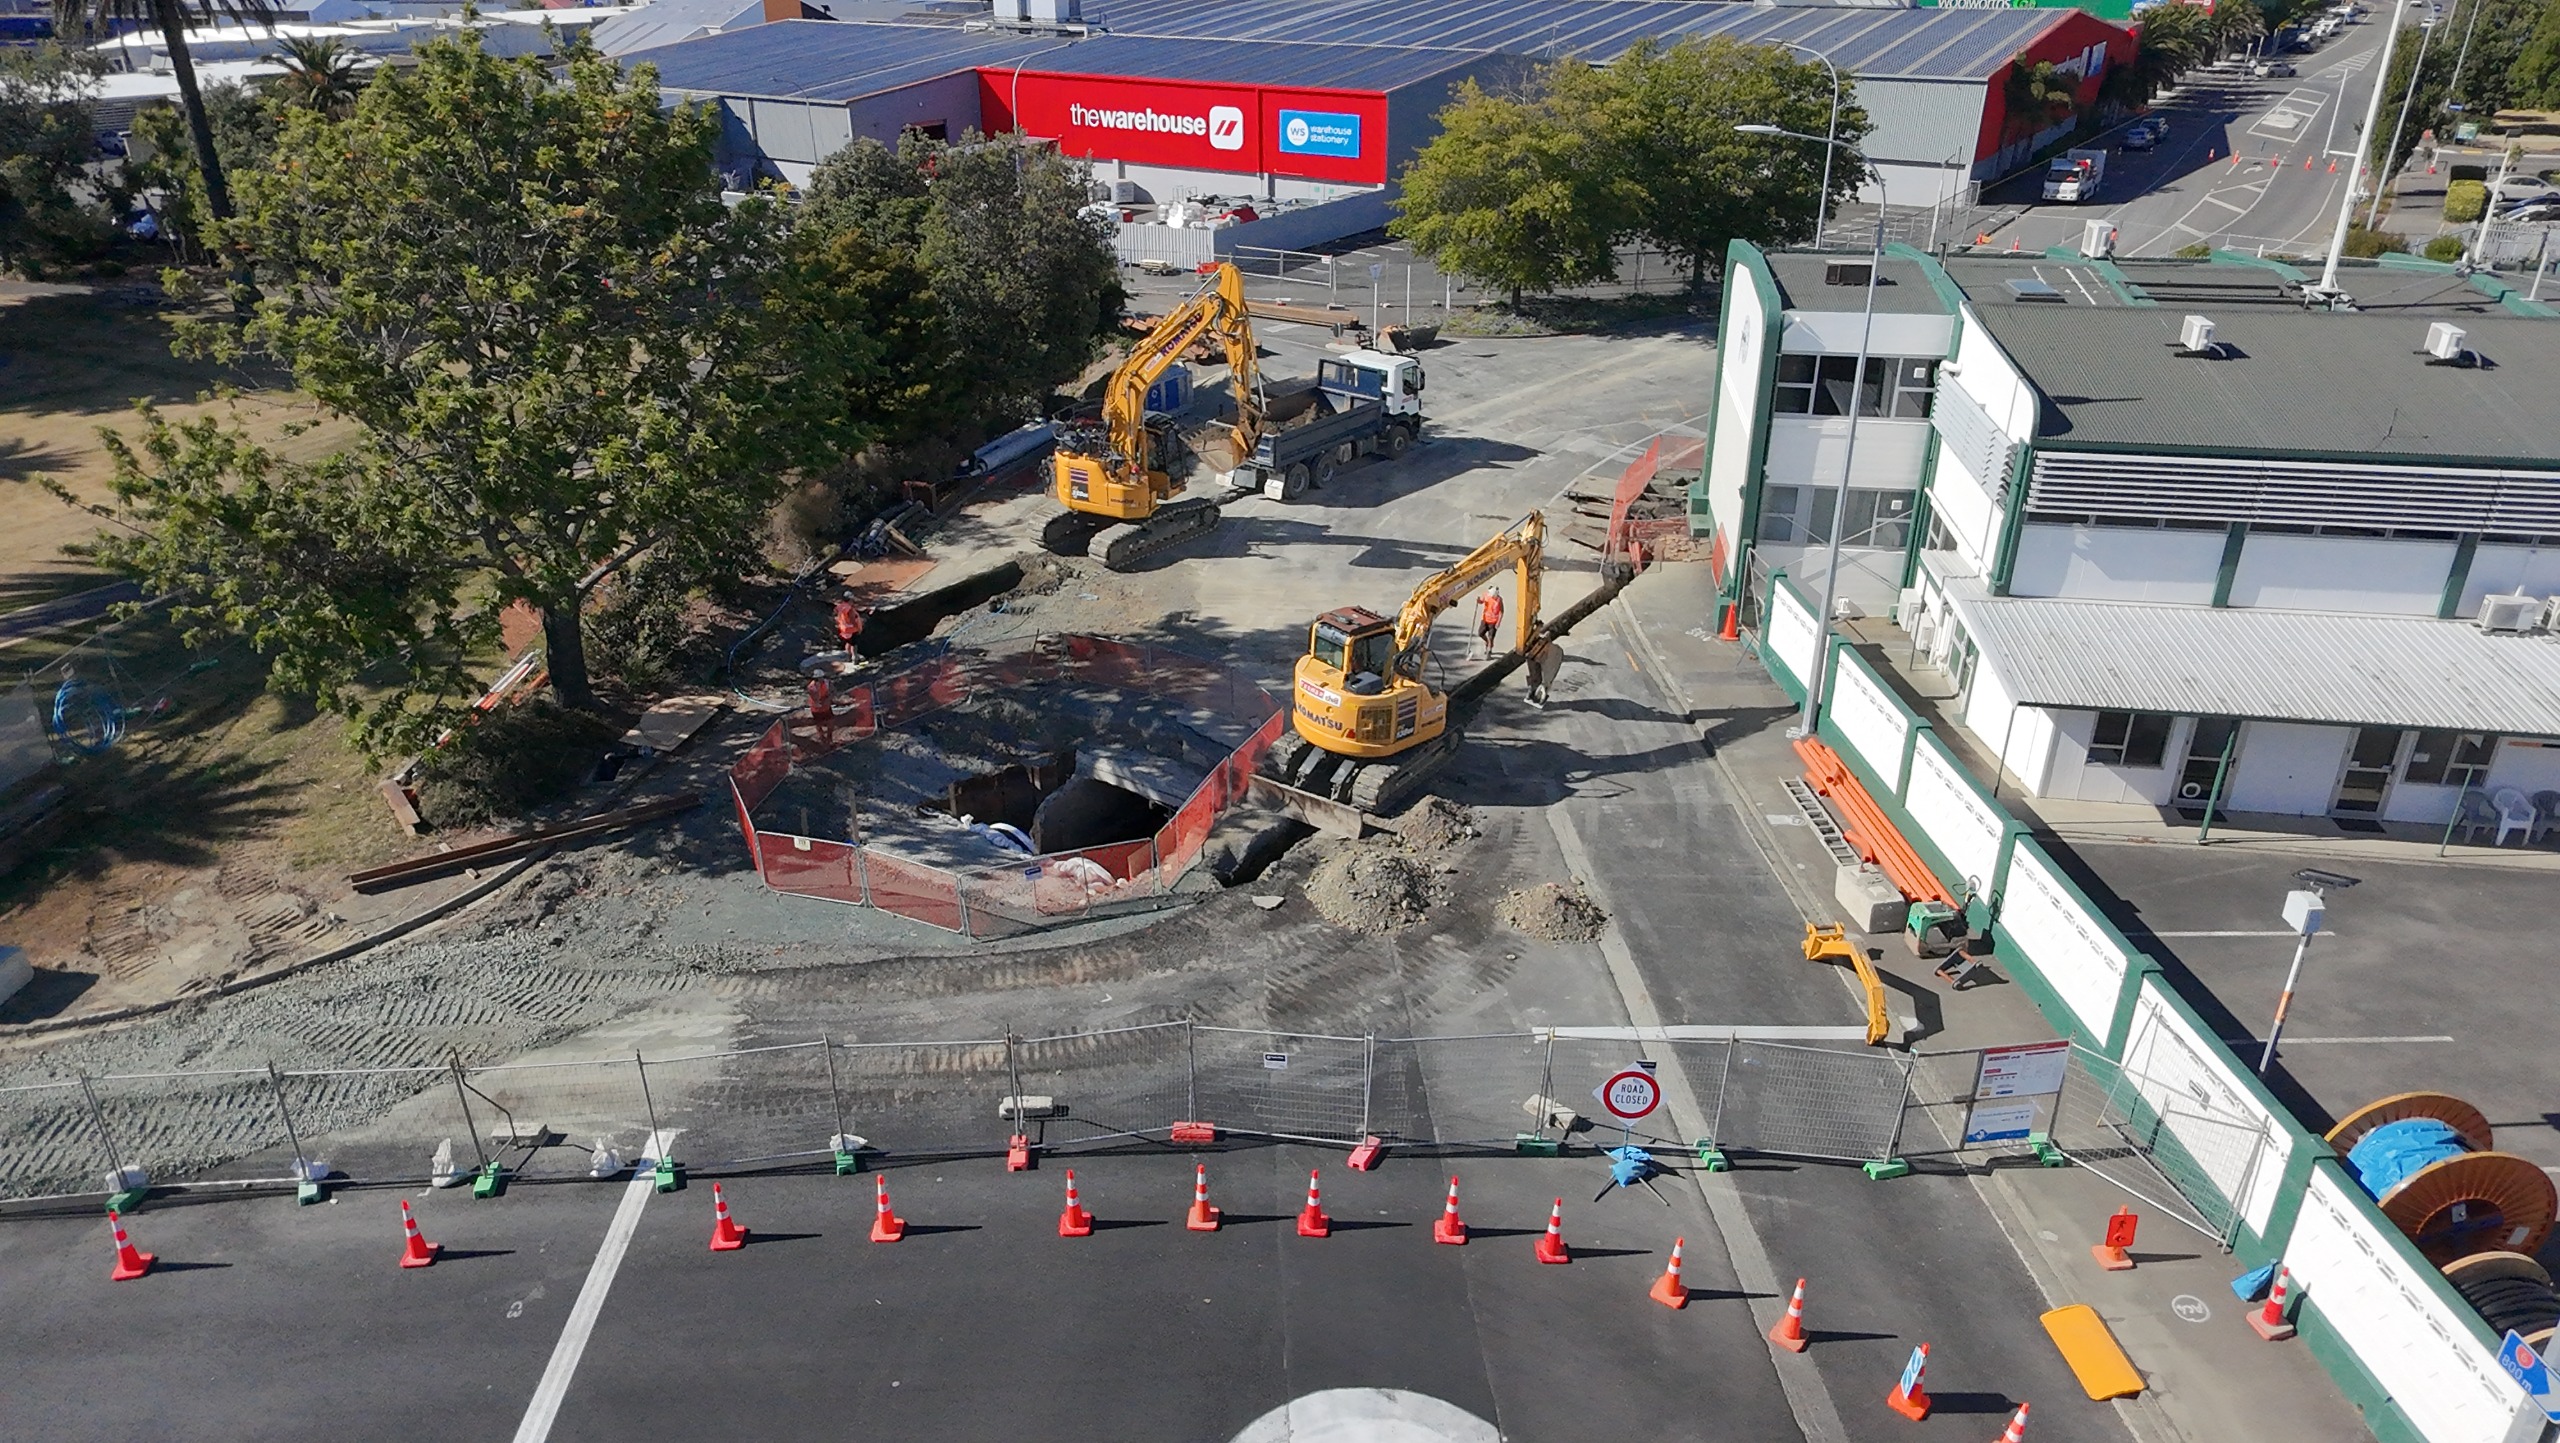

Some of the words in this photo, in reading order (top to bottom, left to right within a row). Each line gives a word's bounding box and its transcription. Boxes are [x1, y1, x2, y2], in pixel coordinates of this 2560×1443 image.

[1290, 127, 1306, 137] WS
[1310, 126, 1352, 136] warehouse
[1310, 134, 1349, 146] stationery
[1161, 312, 1203, 357] KOMATSU
[1297, 703, 1343, 731] KOMATSU
[1621, 1083, 1644, 1094] ROAD
[1615, 1094, 1648, 1105] CLOSED
[2501, 1353, 2523, 1380] 800
[2521, 1378, 2533, 1392] m
